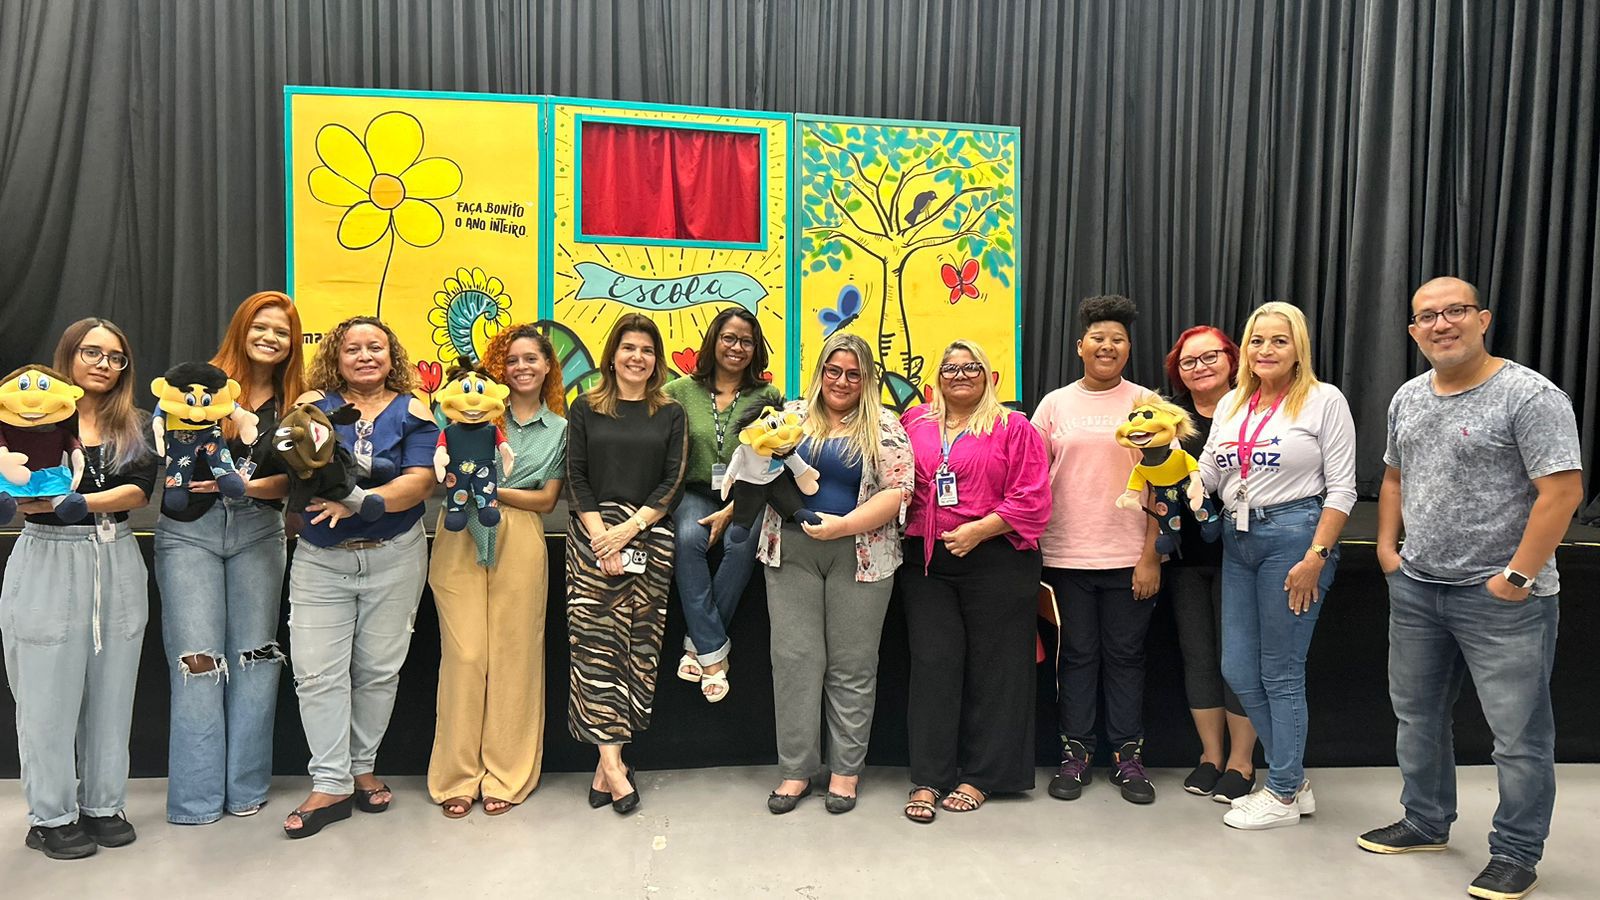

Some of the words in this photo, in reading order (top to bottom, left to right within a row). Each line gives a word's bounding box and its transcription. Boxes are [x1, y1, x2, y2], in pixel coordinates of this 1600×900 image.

[456, 202, 482, 215] FAÇA
[455, 217, 462, 228] O
[465, 217, 486, 230] ANO
[608, 276, 752, 305] Escola
